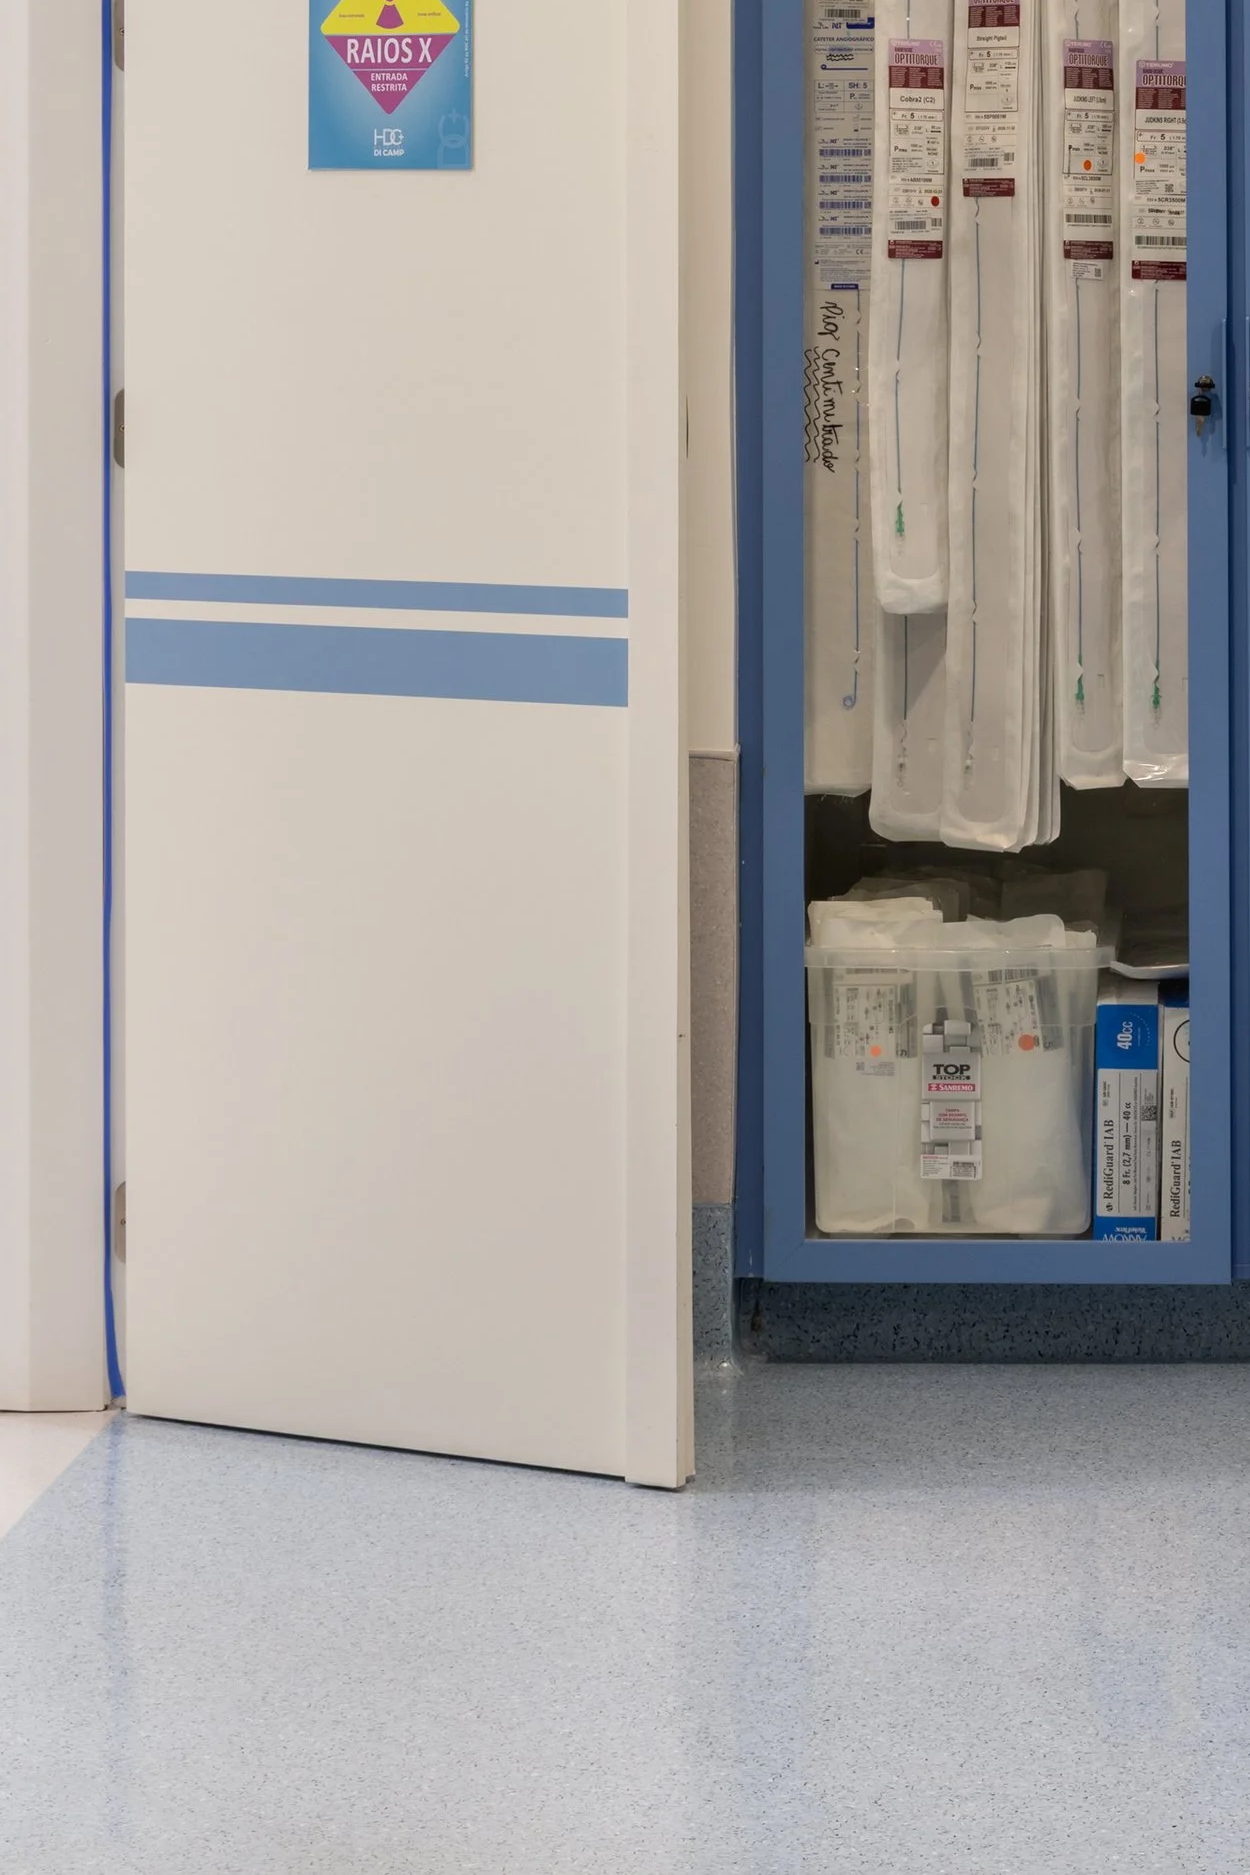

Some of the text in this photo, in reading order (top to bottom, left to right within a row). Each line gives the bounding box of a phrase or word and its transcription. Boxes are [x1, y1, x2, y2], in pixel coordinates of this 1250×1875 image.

[346, 37, 433, 64] RAIOS X
[894, 53, 938, 65] OPTITORQUE
[1068, 54, 1107, 66] OPTITORQUE
[370, 73, 408, 81] ENTRADA
[371, 83, 408, 92] RESTRITA
[923, 96, 936, 104] (C2)
[1117, 1021, 1133, 1050] 40cc
[933, 1064, 971, 1075] TOP
[1122, 1110, 1131, 1121] 40
[1103, 1119, 1114, 1141] IAB
[1122, 1134, 1133, 1151] mm)
[1103, 1144, 1114, 1200] RediGuard
[1122, 1168, 1131, 1177] Fr.
[1169, 1140, 1181, 1218] RediGuard IAB
